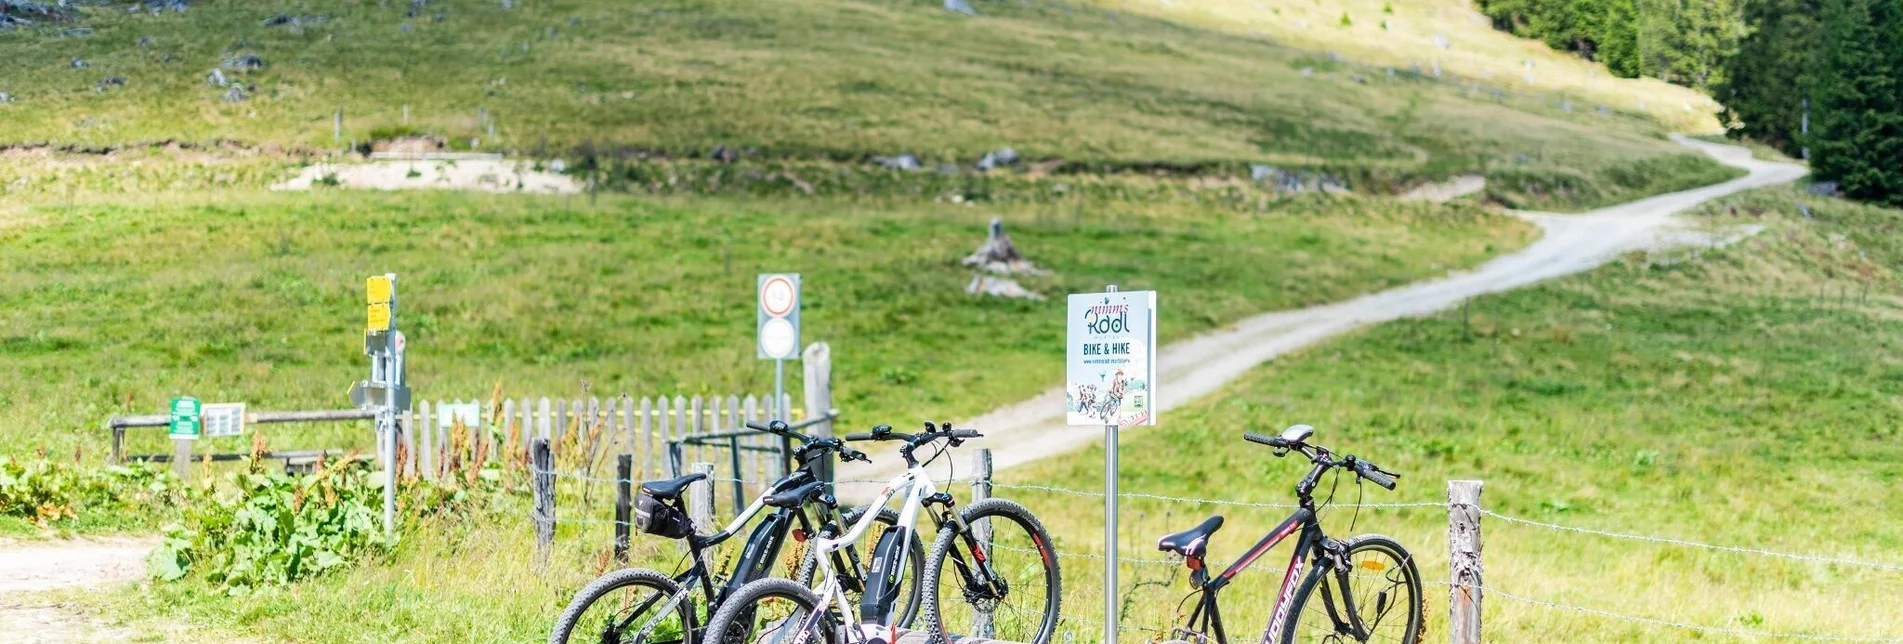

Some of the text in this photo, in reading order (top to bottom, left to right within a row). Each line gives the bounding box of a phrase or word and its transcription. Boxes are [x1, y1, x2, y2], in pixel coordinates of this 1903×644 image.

[1083, 342, 1130, 355] BIKE & HIKE
